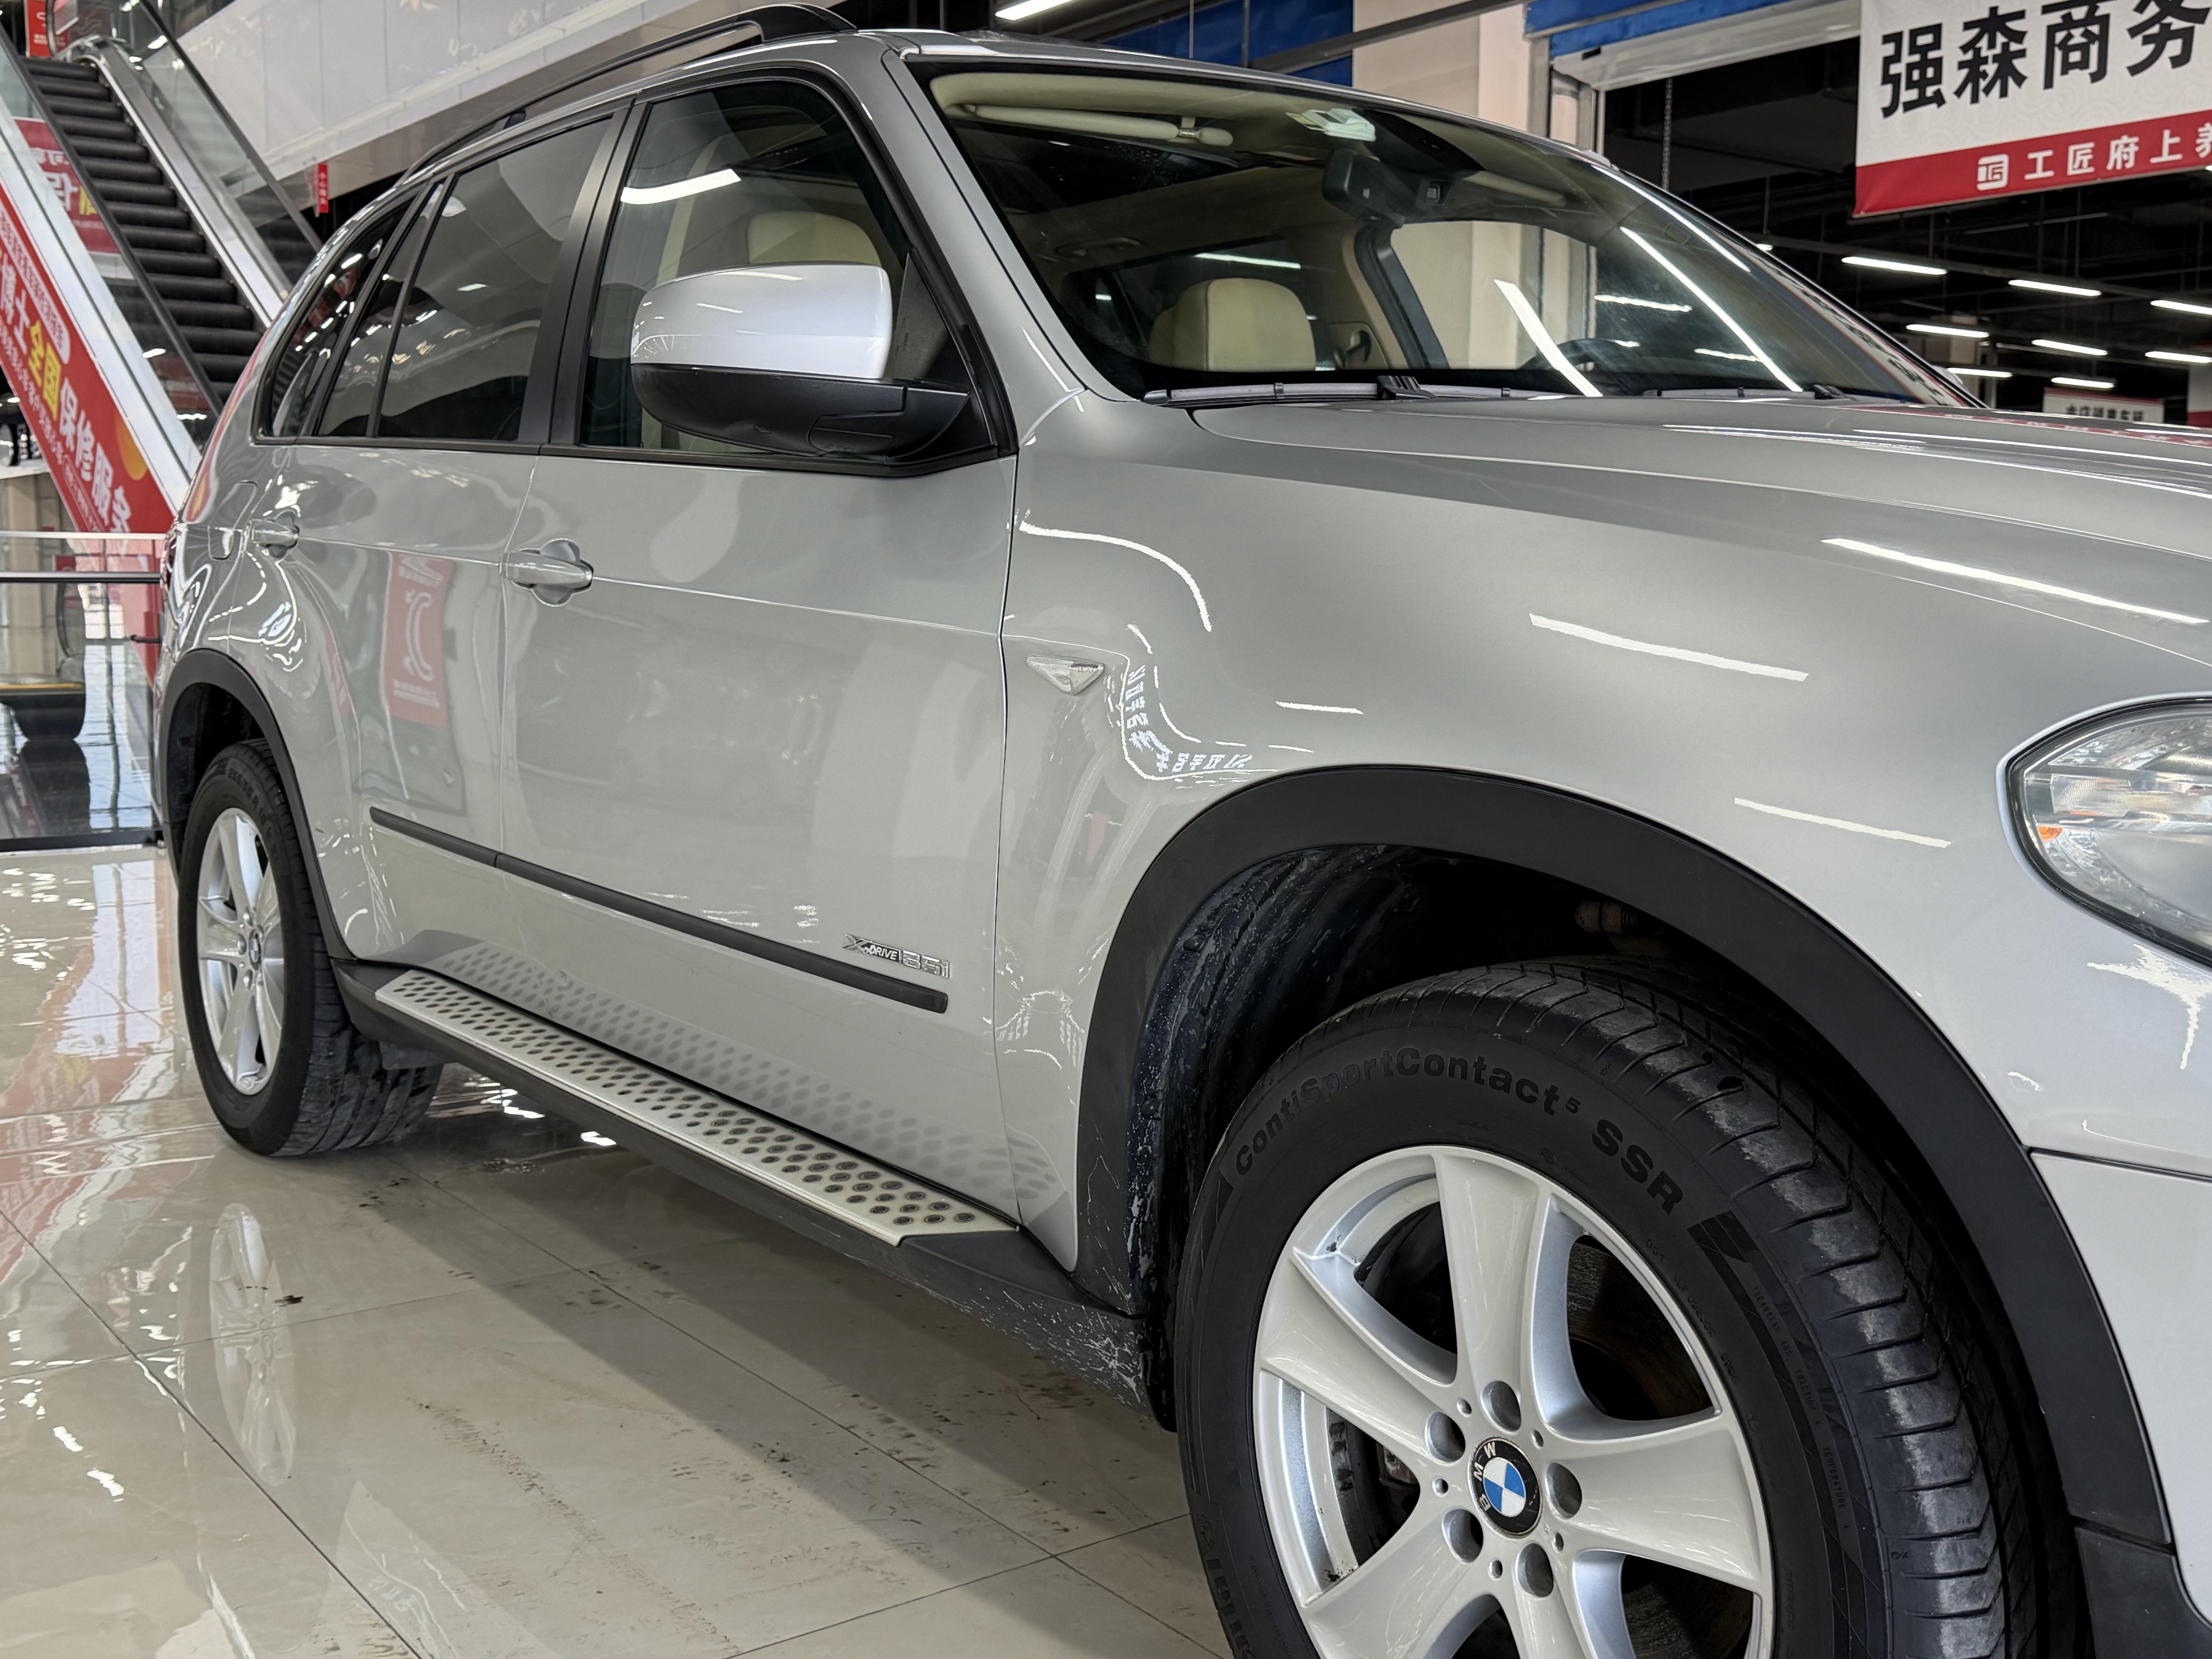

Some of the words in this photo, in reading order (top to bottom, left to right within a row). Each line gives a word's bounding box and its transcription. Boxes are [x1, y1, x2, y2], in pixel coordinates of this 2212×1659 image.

[1881, 0, 2211, 118] 强森商务
[1591, 1118, 1684, 1215] SSR
[1474, 1441, 1496, 1511] BMW
